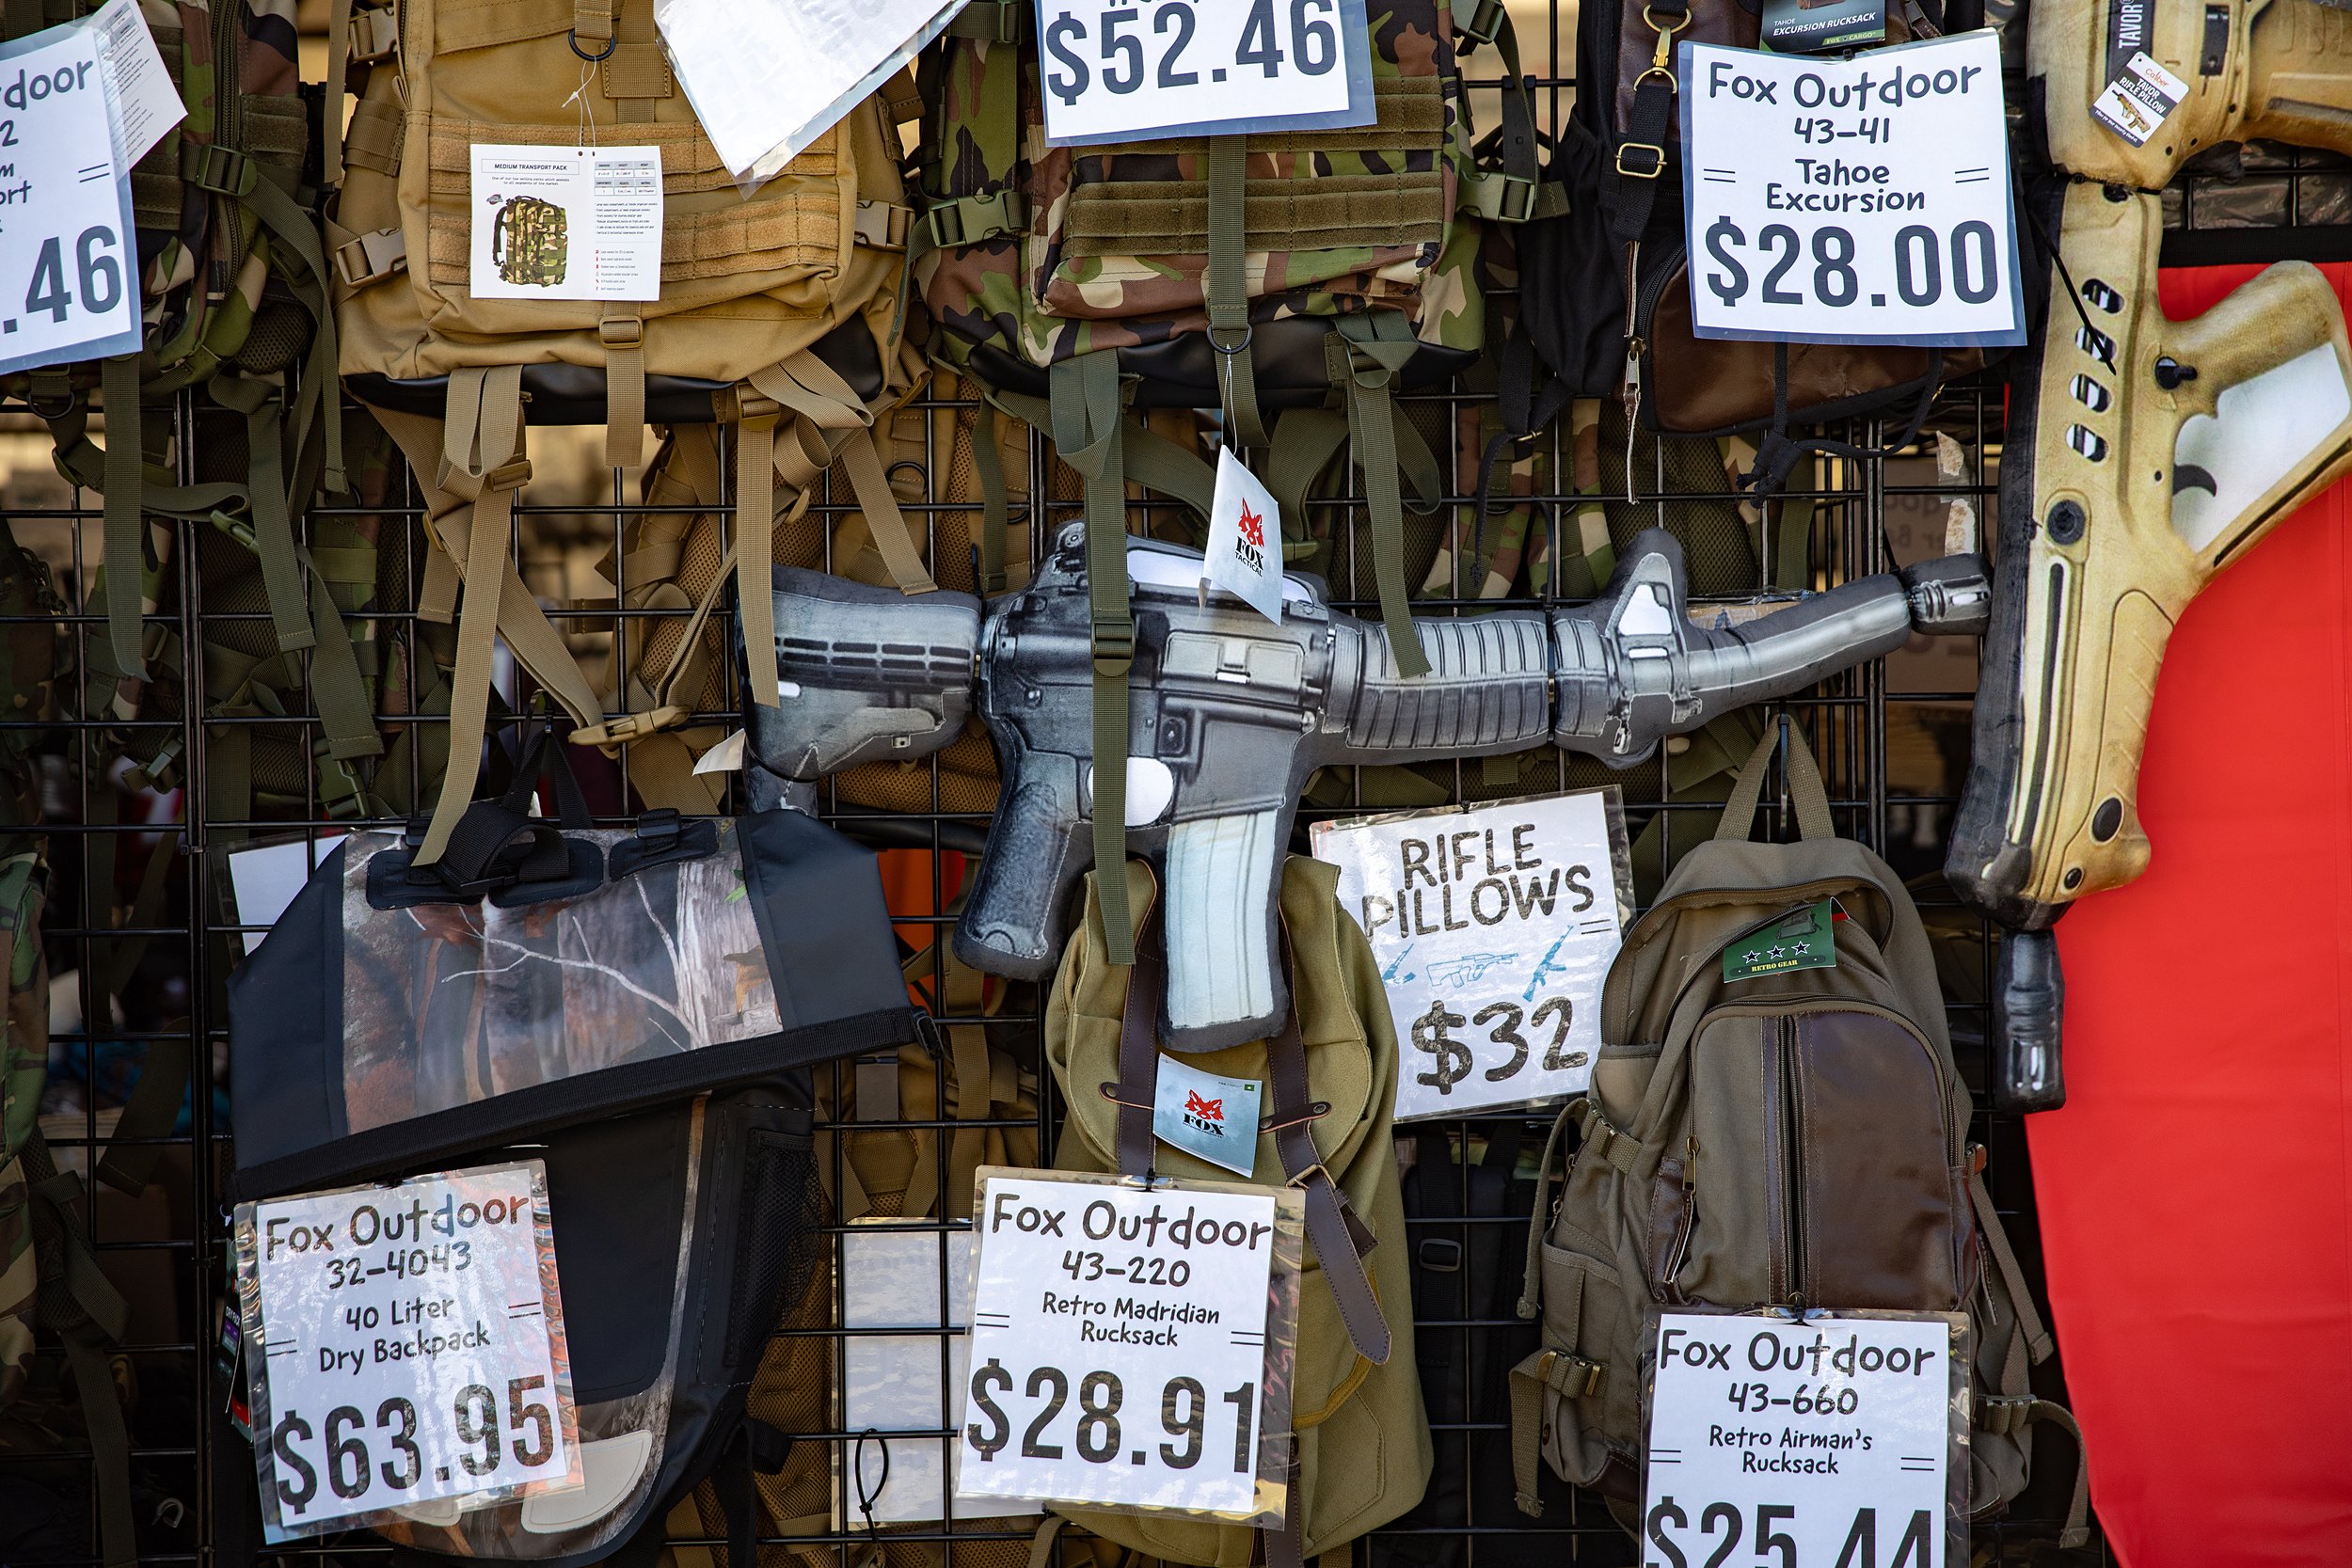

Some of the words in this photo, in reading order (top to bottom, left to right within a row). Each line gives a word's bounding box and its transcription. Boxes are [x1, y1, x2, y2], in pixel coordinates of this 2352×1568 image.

[1773, 18, 1796, 26] TAHOE
[1773, 22, 1826, 36] EXCURSION
[1826, 12, 1876, 27] RUCKSACK
[2119, 4, 2143, 49] TAVOR
[1045, 0, 1337, 106] $52.46
[0, 60, 93, 111] door
[1709, 61, 1778, 105] Fox
[1793, 65, 1982, 112] Outdoor
[2119, 76, 2139, 96] RIFLE
[2137, 90, 2167, 114] PILLOW
[2137, 77, 2160, 99] TAVOR
[2145, 68, 2169, 87] Caliber
[1794, 118, 1890, 145] 43-41
[1795, 158, 1890, 186] Tahoe
[1766, 182, 1925, 213] Excursion
[1705, 215, 1999, 308] $28.00
[1235, 536, 1263, 570] FOX
[1235, 551, 1263, 577] TACTICAL
[1400, 823, 1542, 890] RIFLE
[1361, 864, 1594, 941] PILLOWS
[1752, 963, 1776, 972] RETRO
[1411, 996, 1589, 1096] $32
[1184, 1113, 1224, 1136] FOX
[266, 1216, 334, 1260] Fox
[349, 1194, 530, 1247] Outdoor
[992, 1193, 1067, 1238] Fox
[1082, 1199, 1272, 1251] Outdoor
[326, 1241, 471, 1290] 32-4043
[1062, 1250, 1191, 1287] 43-220
[346, 1306, 379, 1332] 40
[391, 1296, 454, 1325] Liter
[1042, 1291, 1106, 1316] Retro
[1114, 1297, 1220, 1324] Madridian
[319, 1345, 365, 1375] Dry
[374, 1321, 491, 1363] Backpack
[1081, 1320, 1178, 1347] Rucksack
[1661, 1329, 1732, 1371] Fox
[1748, 1331, 1935, 1378] Outdoor
[967, 1358, 1255, 1473] $28.91
[1728, 1382, 1859, 1416] 43-660
[273, 1374, 555, 1515] $63.95
[1709, 1424, 1772, 1448] Retro
[1779, 1426, 1872, 1450] Airman's
[1742, 1450, 1839, 1474] Rucksack
[1646, 1496, 1931, 1568] $2544
